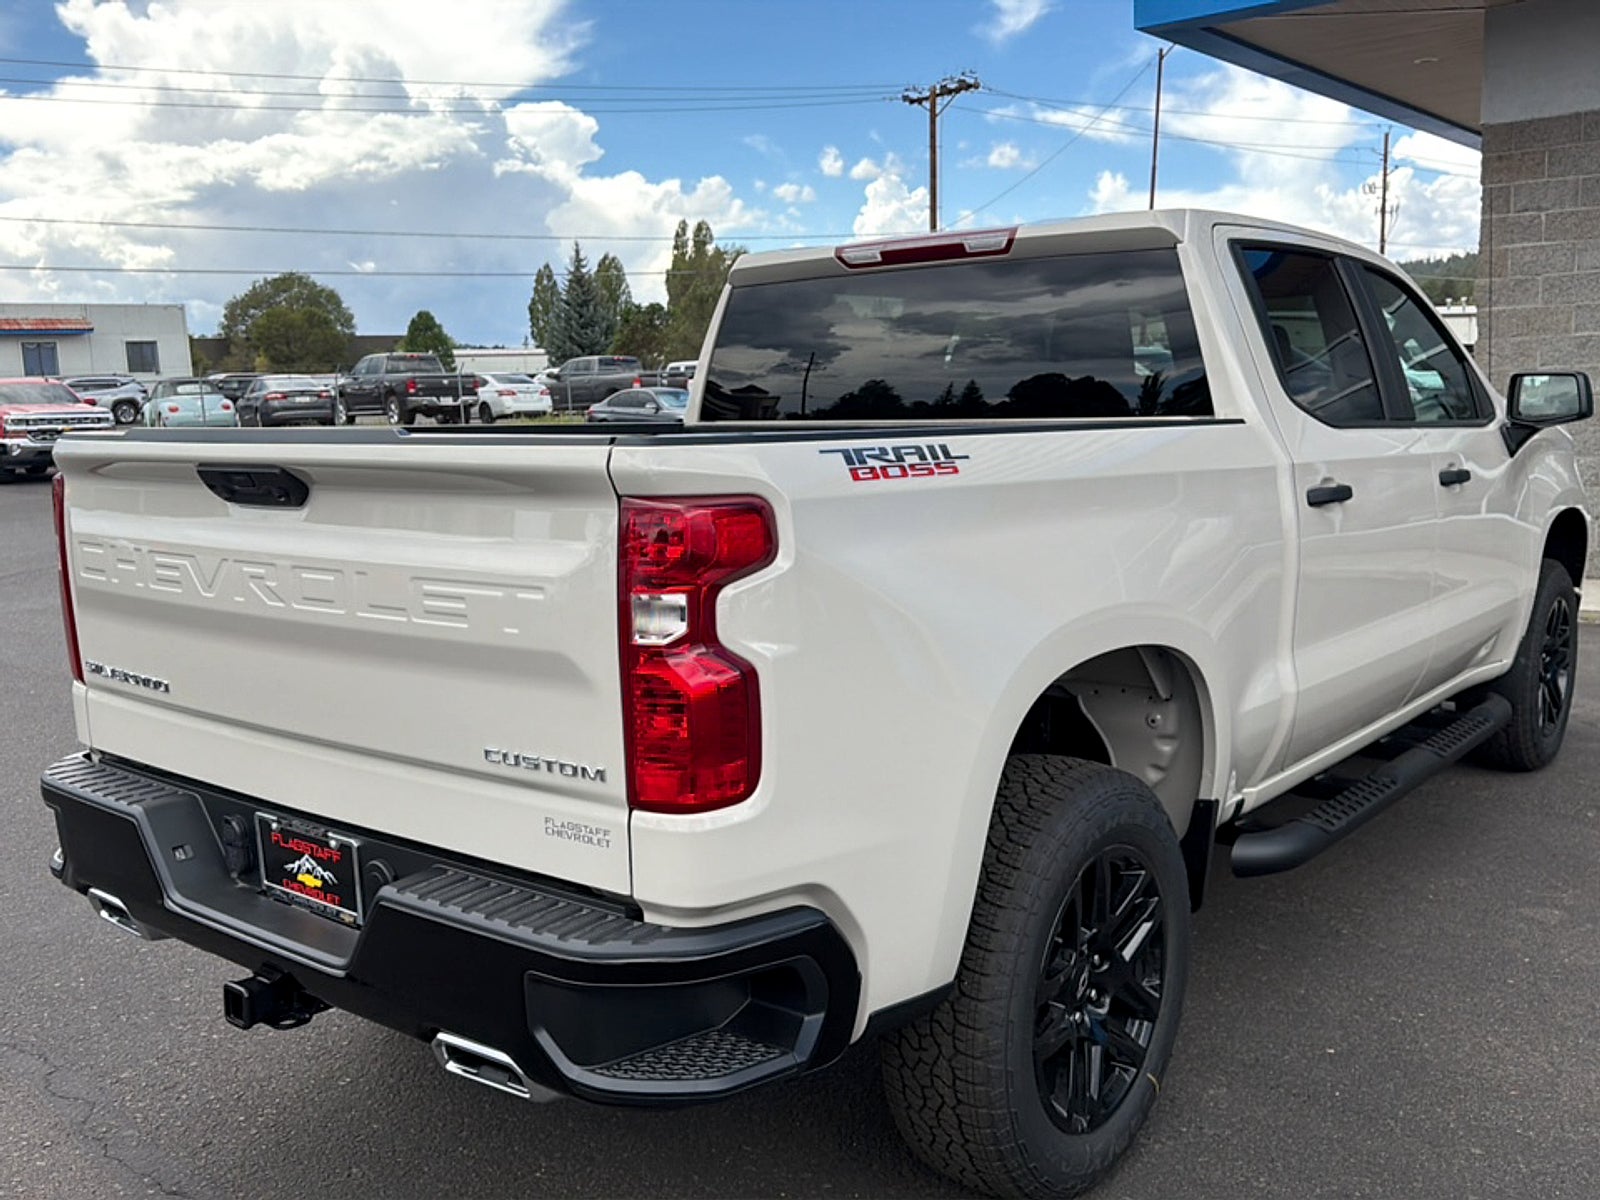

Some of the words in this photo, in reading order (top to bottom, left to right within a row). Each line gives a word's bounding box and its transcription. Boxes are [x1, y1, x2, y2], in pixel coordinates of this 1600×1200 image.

[819, 444, 969, 466] TRAIL
[849, 461, 960, 481] BOSS
[78, 540, 546, 634] CHEVROLET
[484, 748, 606, 782] CUSTOM
[544, 816, 611, 838] FLAGSTAFF
[545, 826, 611, 849] CHEVROLET
[271, 832, 342, 863] FLAGSTAFF
